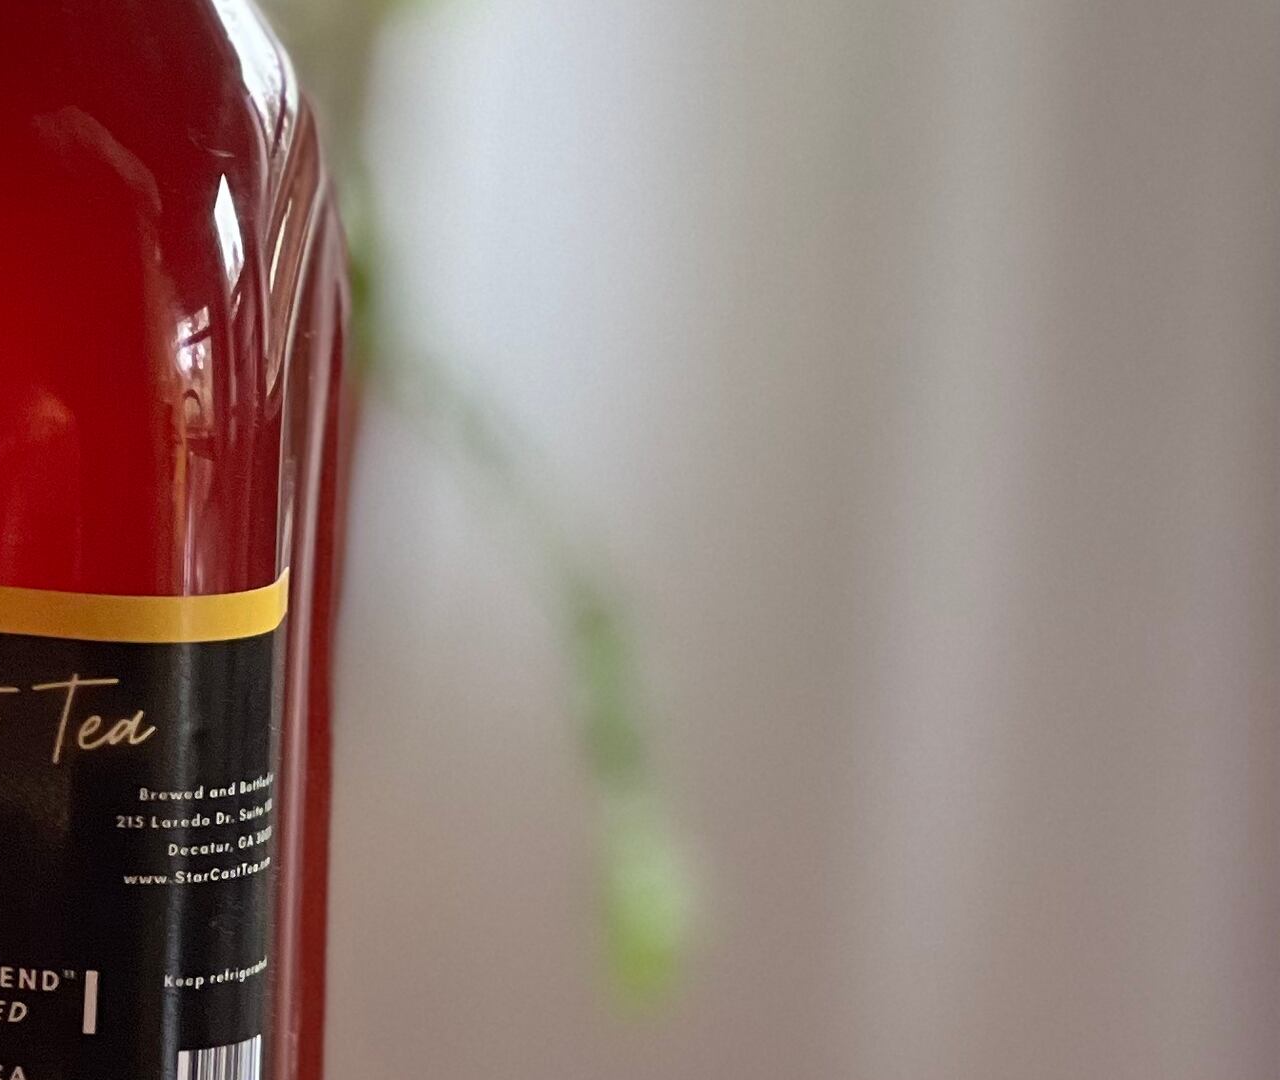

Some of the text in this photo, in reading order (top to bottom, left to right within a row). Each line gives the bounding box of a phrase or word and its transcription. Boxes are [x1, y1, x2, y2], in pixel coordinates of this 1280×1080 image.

[32, 673, 157, 765] Tea
[139, 785, 204, 801] Brewed
[209, 782, 236, 798] and
[116, 815, 144, 828] 215
[151, 813, 211, 829] Laredo
[215, 812, 235, 825] Dr.
[168, 841, 234, 856] Decatur,
[238, 835, 253, 849] GA
[164, 975, 205, 990] Keep
